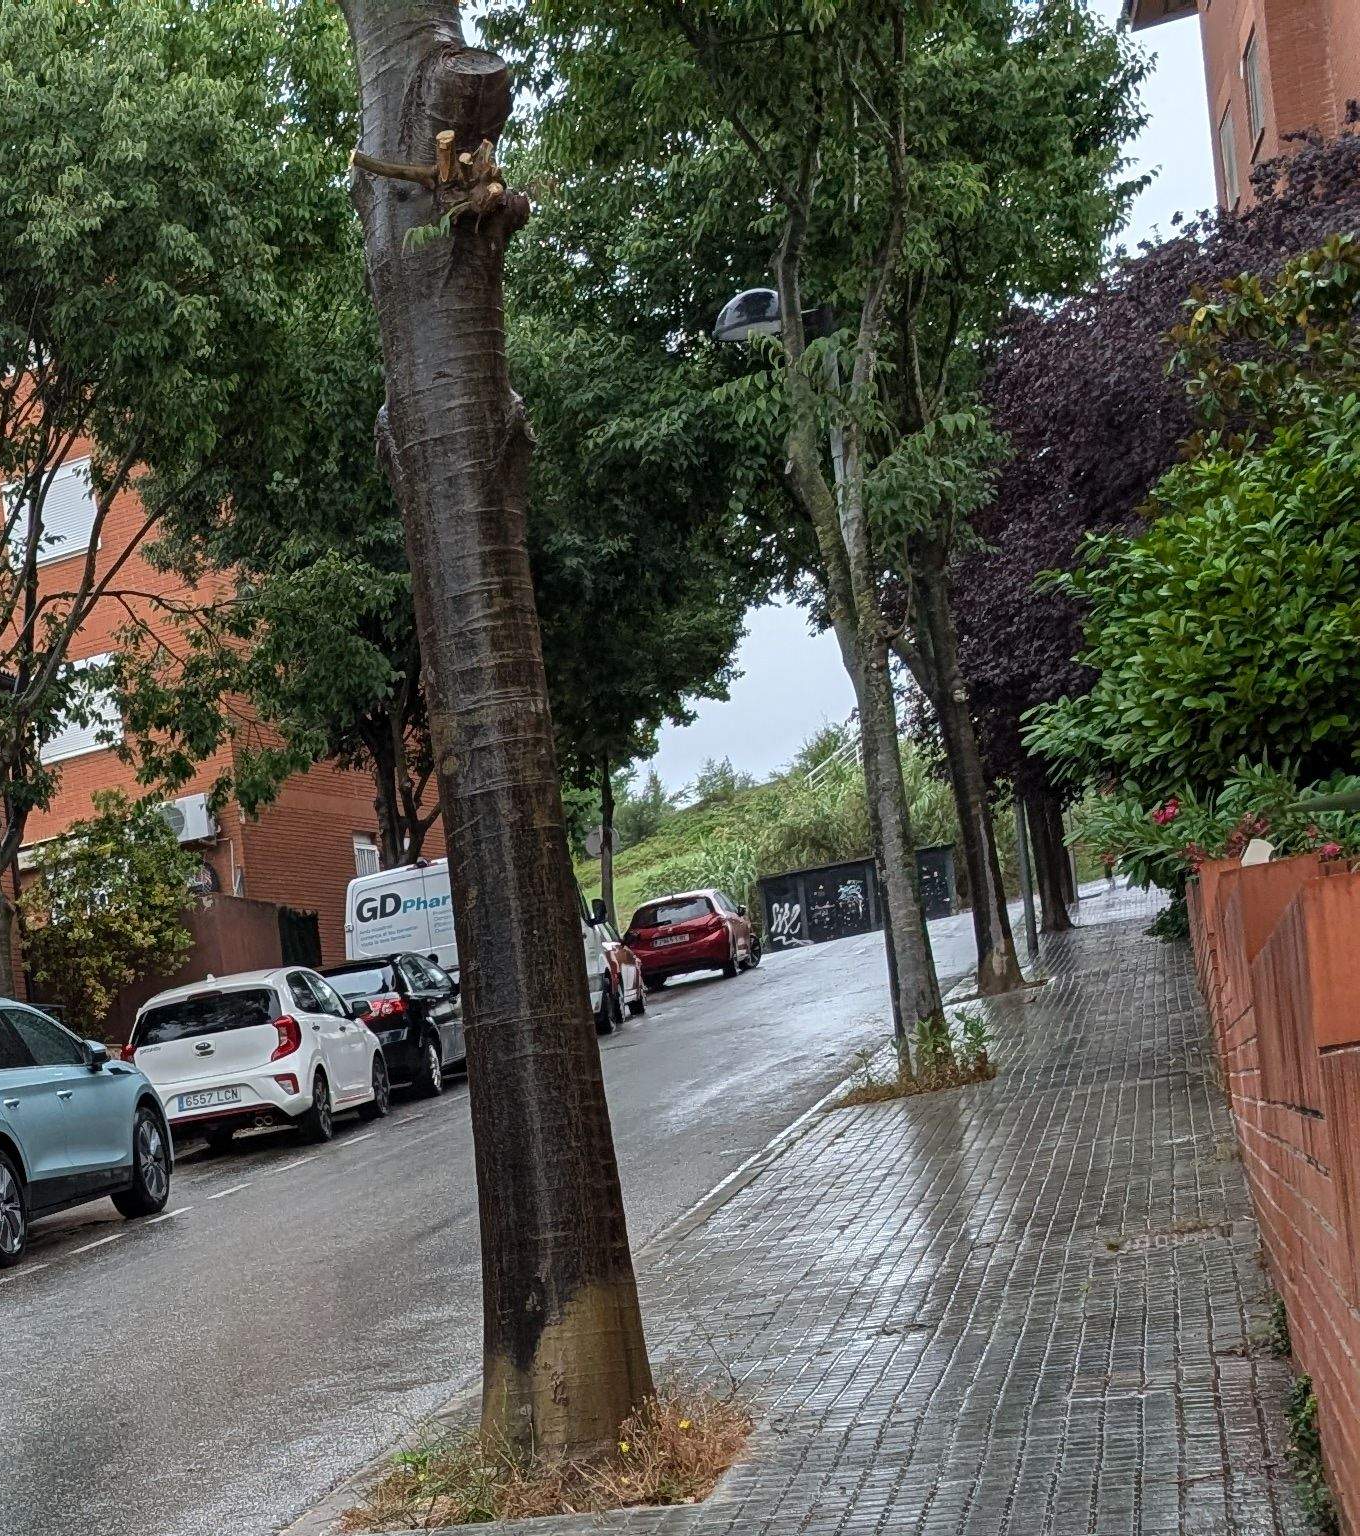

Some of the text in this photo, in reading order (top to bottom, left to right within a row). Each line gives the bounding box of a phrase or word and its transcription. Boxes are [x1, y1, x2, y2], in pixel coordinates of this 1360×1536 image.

[356, 893, 451, 923] GDPhar
[185, 1088, 239, 1107] 6557 LCN
